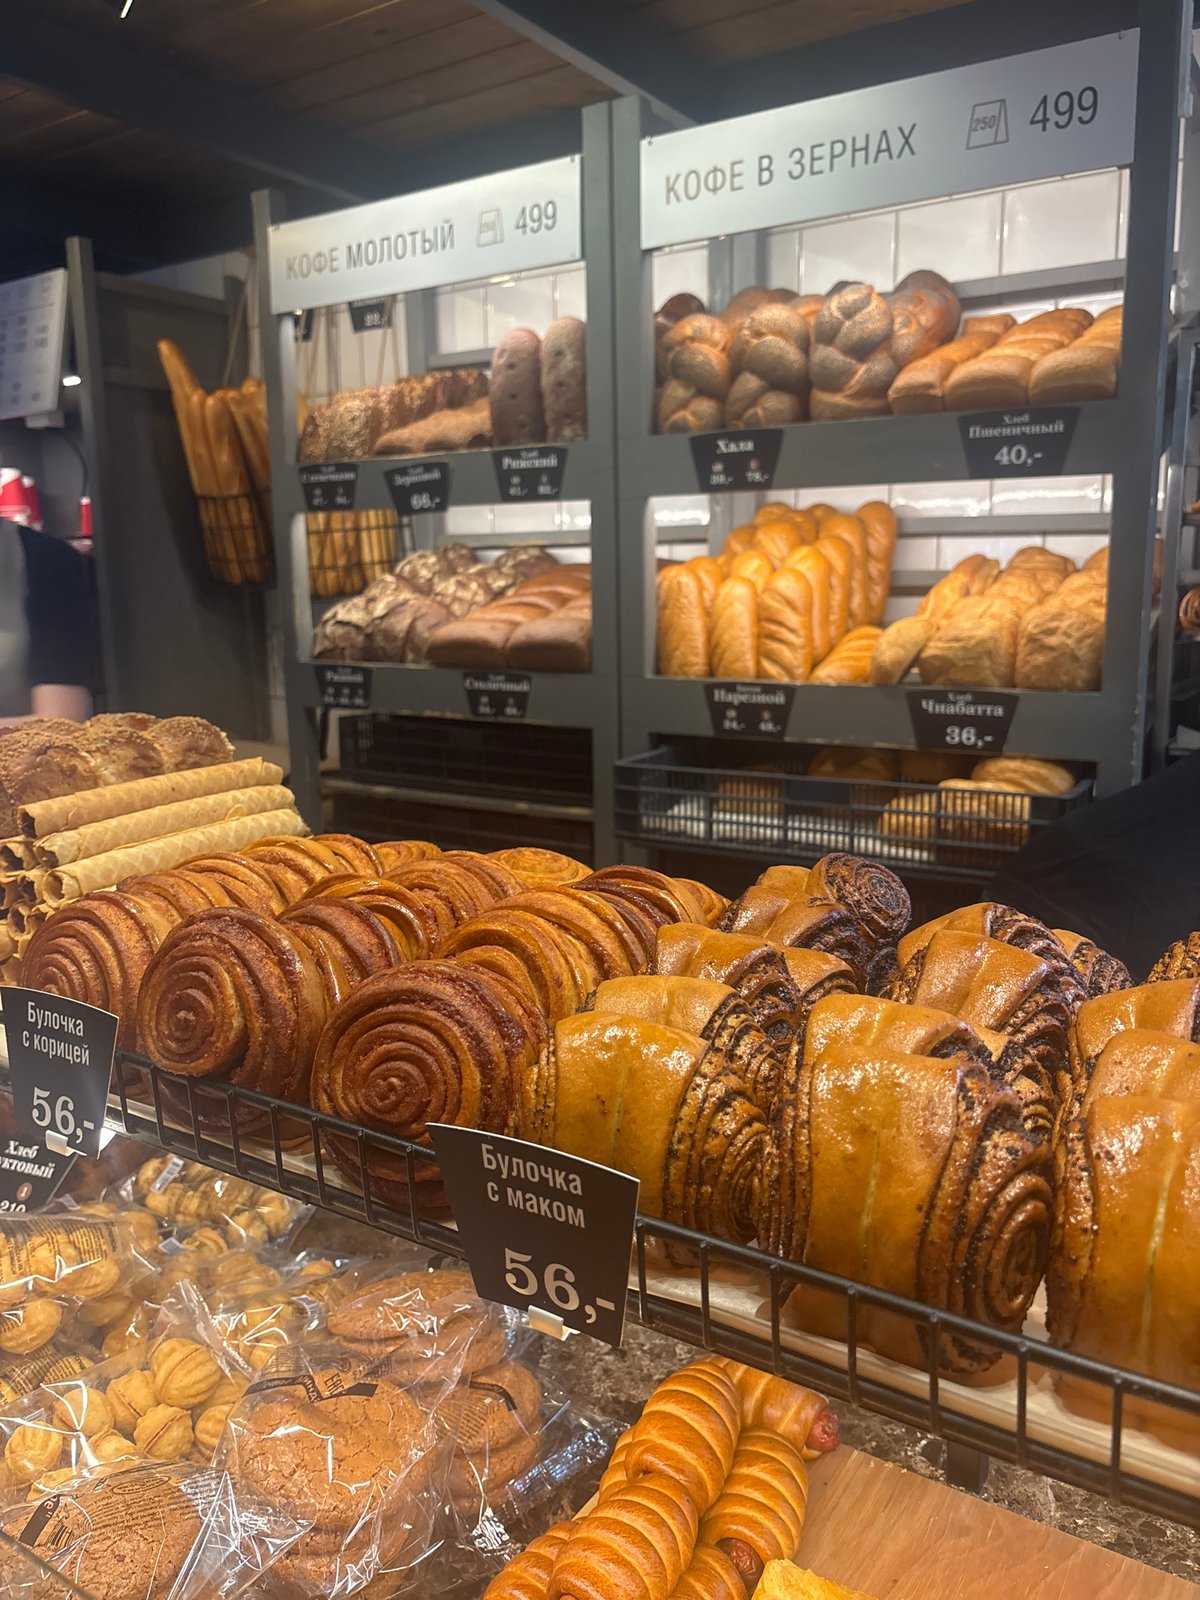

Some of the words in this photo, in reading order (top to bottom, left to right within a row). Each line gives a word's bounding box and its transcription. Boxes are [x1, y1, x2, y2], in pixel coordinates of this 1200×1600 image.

[971, 114, 997, 133] 250
[1028, 85, 1099, 133] 499
[665, 158, 745, 206] КОФЕ
[757, 154, 774, 187] В
[787, 122, 918, 182] ЗЕРНАХ
[514, 200, 558, 236] 499
[285, 247, 341, 282] КОФЕ
[345, 217, 456, 270] МОЛОТЫЙ
[968, 419, 1065, 439] Пшеничный
[1002, 412, 1029, 425] Хлеб
[716, 439, 754, 454] Хала
[994, 444, 1043, 467] 40,-
[713, 689, 785, 706] Нарезной
[921, 699, 1004, 717] Чиабатта
[945, 725, 994, 749] 36,-
[27, 1001, 84, 1037] Булочка
[22, 1031, 30, 1047] с
[33, 1037, 90, 1066] корицей
[31, 1086, 95, 1144] 56,-
[4, 1140, 39, 1159] Хлеб
[481, 1143, 583, 1196] Булочка
[487, 1181, 499, 1202] с
[506, 1187, 586, 1229] маком
[504, 1247, 616, 1324] 56,-
